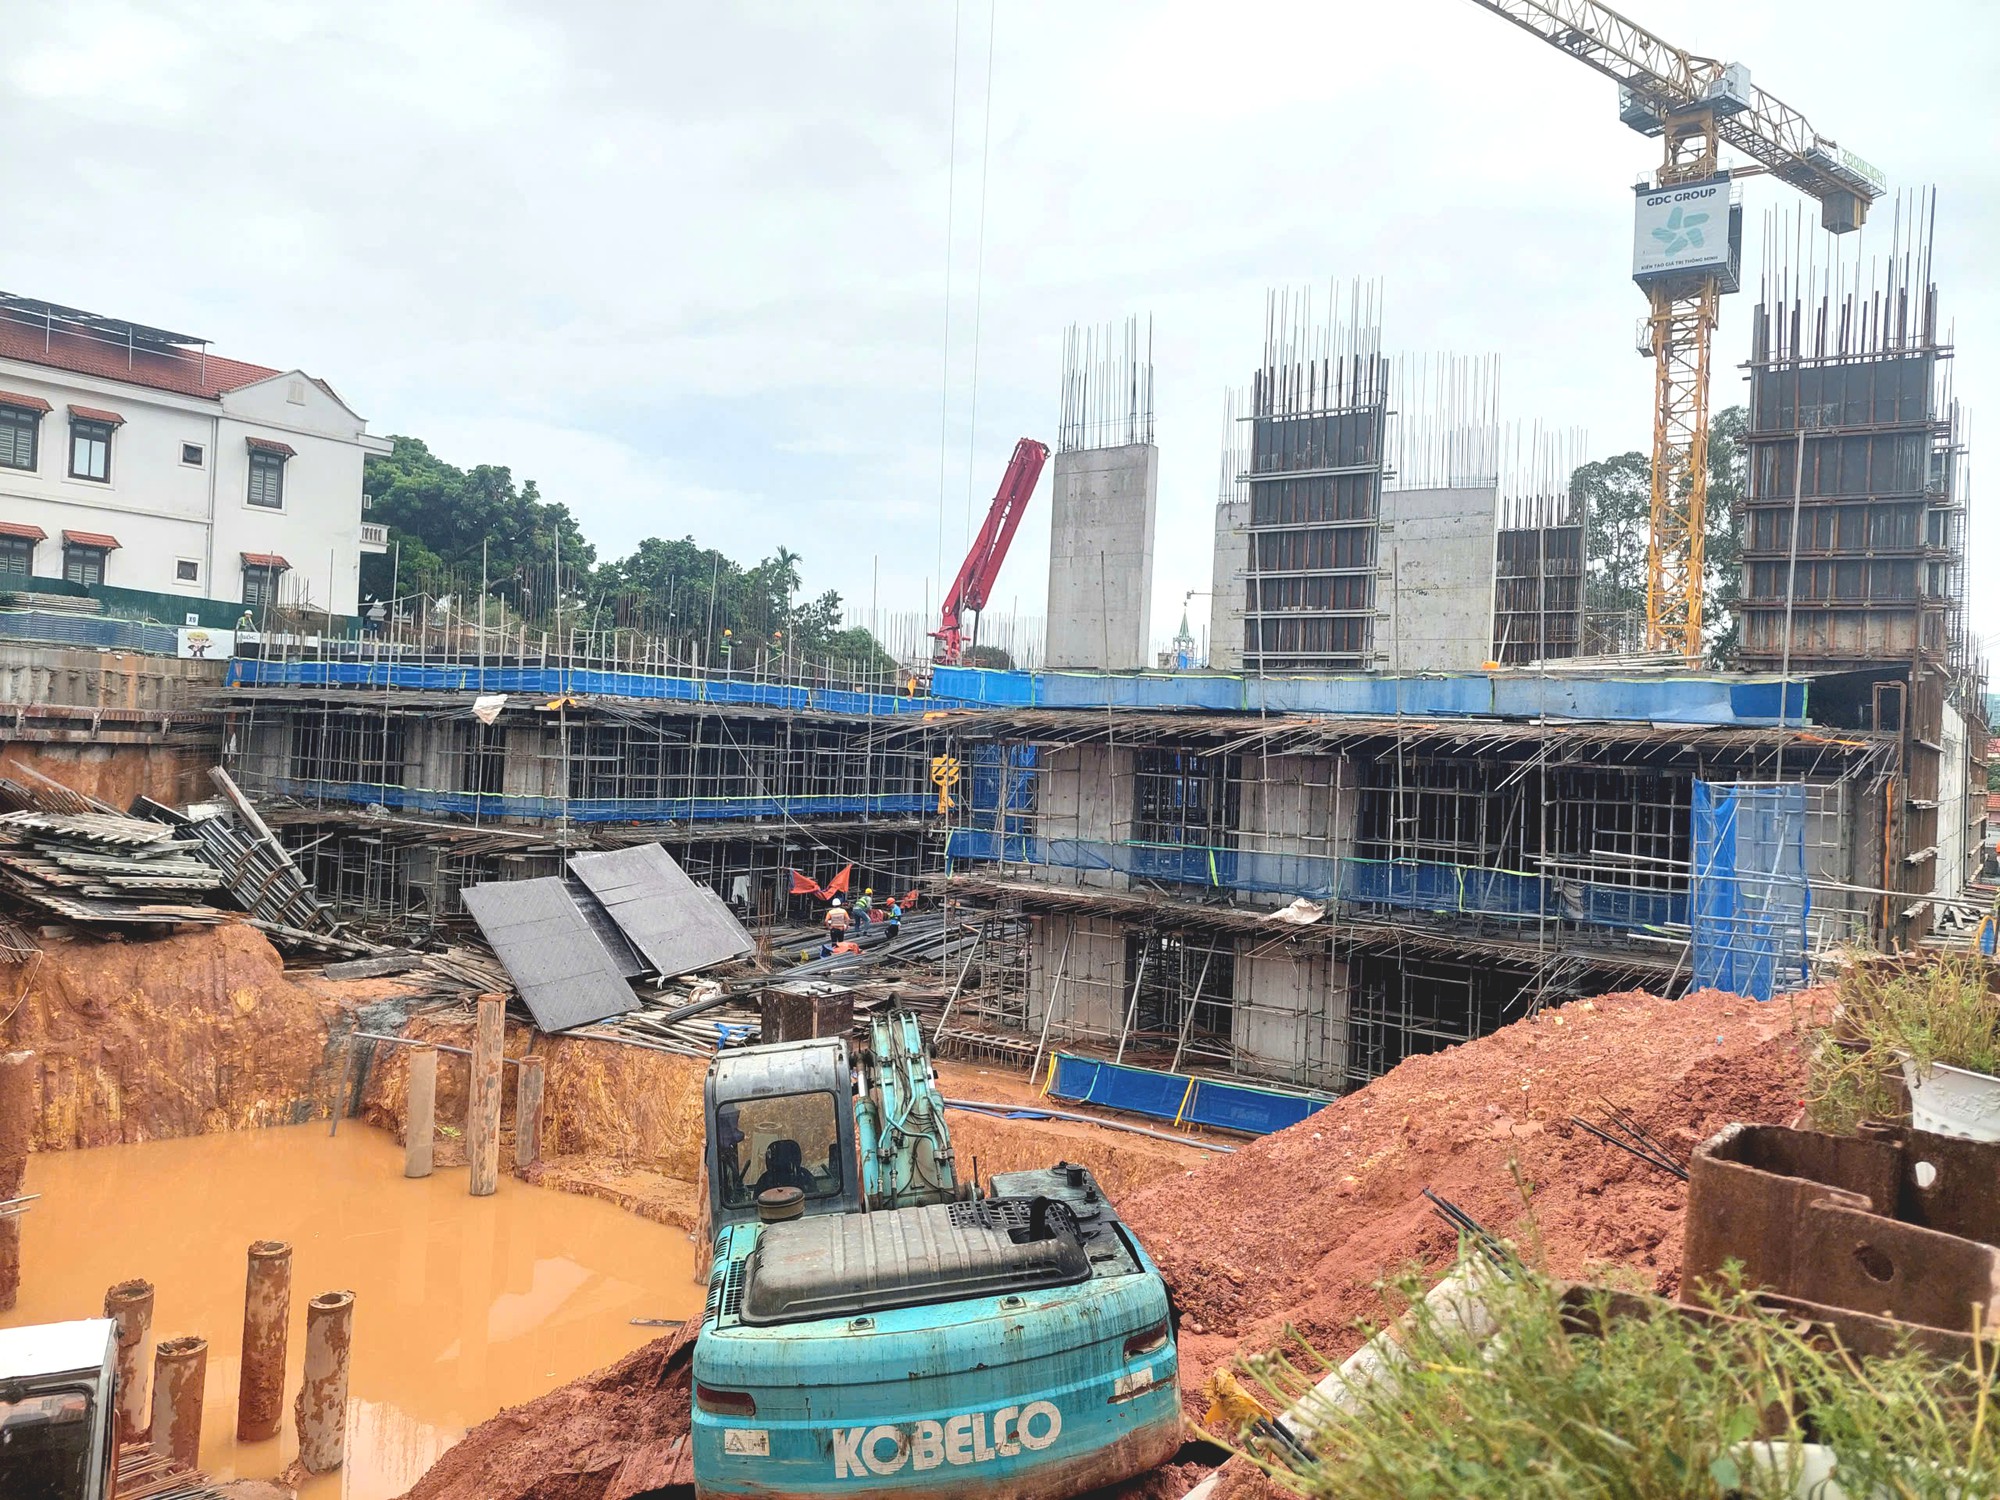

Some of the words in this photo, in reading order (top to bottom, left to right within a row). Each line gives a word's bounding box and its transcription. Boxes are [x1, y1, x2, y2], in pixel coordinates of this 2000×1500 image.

[1646, 195, 1672, 207] GDC
[1674, 188, 1717, 202] GROUP
[832, 1401, 1062, 1479] KOBELCO
